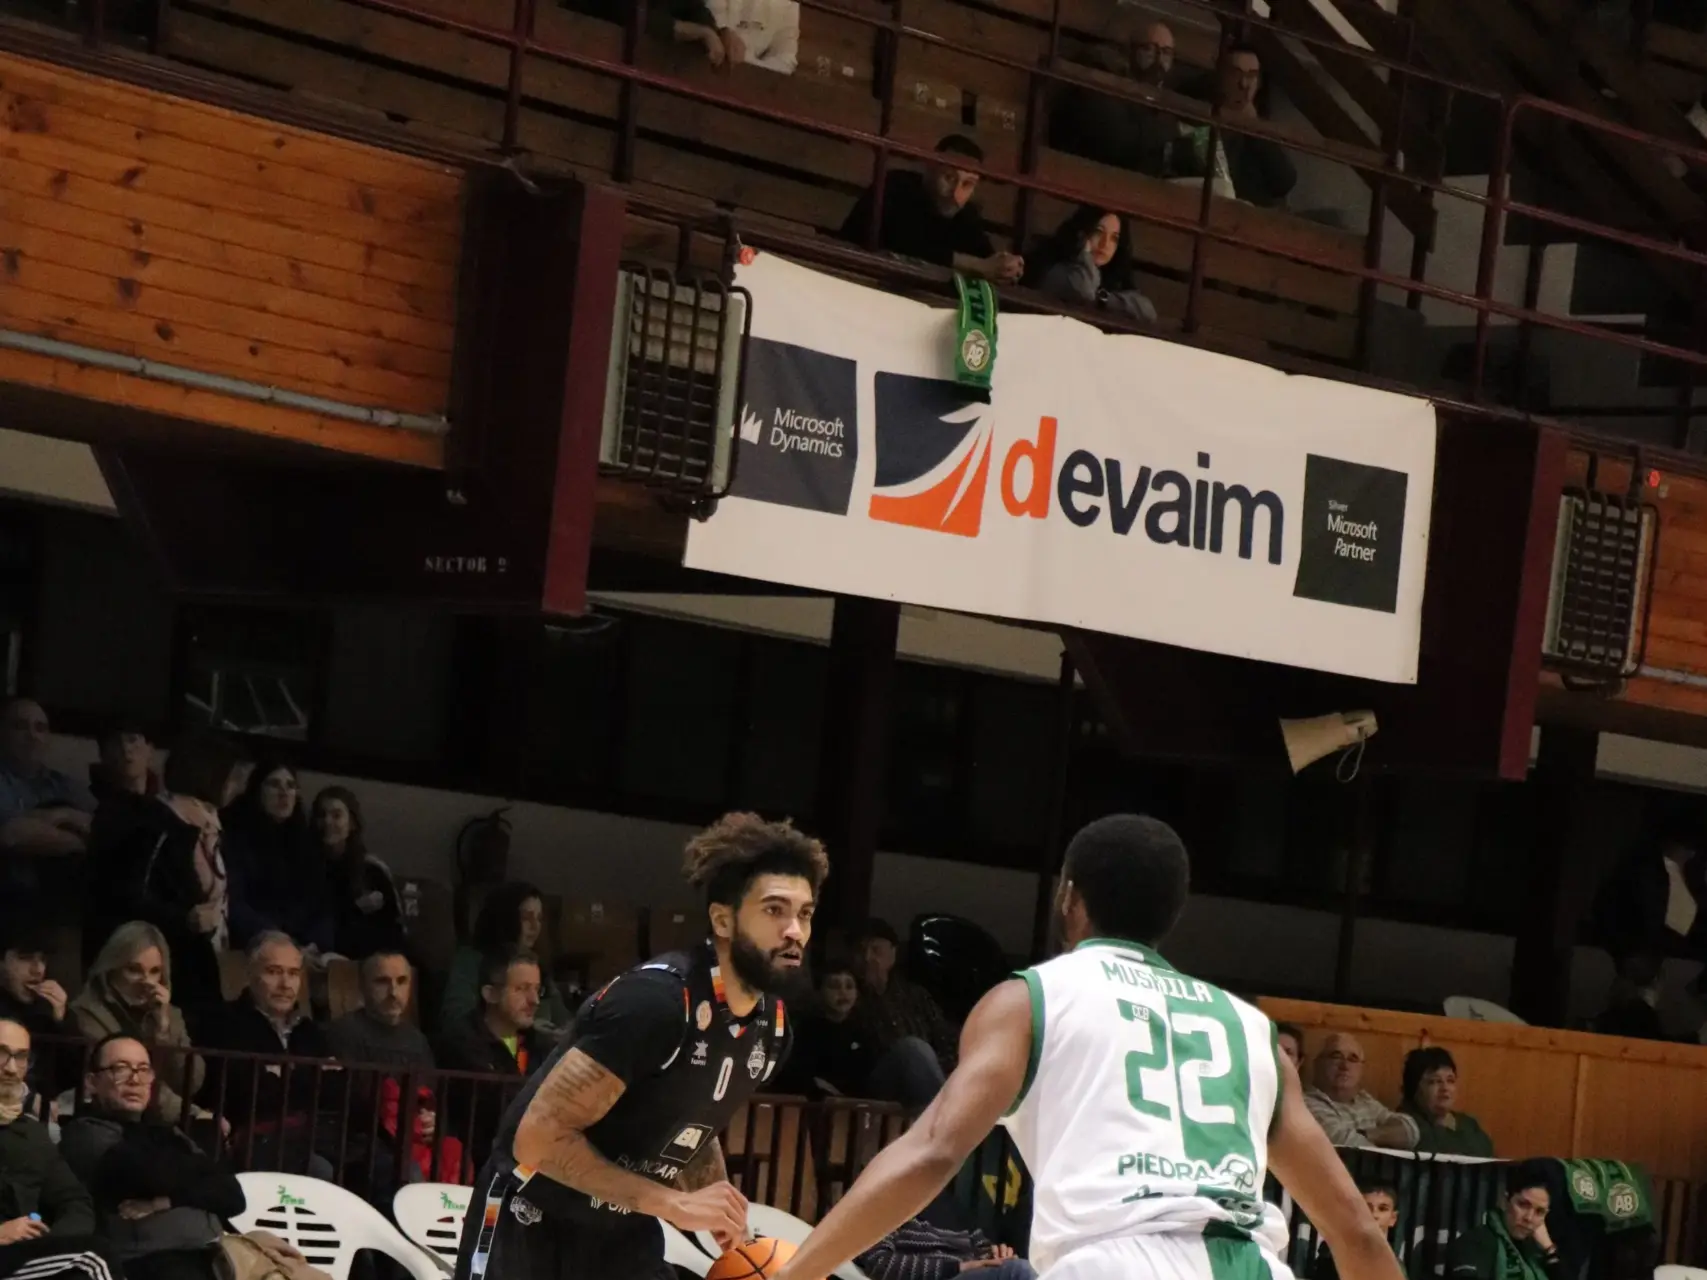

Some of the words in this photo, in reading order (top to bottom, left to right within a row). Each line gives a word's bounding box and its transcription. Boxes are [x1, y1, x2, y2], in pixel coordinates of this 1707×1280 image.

[774, 407, 845, 438] Microsoft
[770, 427, 843, 458] Dynamics
[1000, 415, 1284, 565] devaim
[1327, 513, 1377, 541] Microsoft
[424, 556, 488, 573] SECTOR
[1334, 537, 1377, 561] Partner
[1116, 998, 1236, 1124] 22
[713, 1057, 733, 1101] 0
